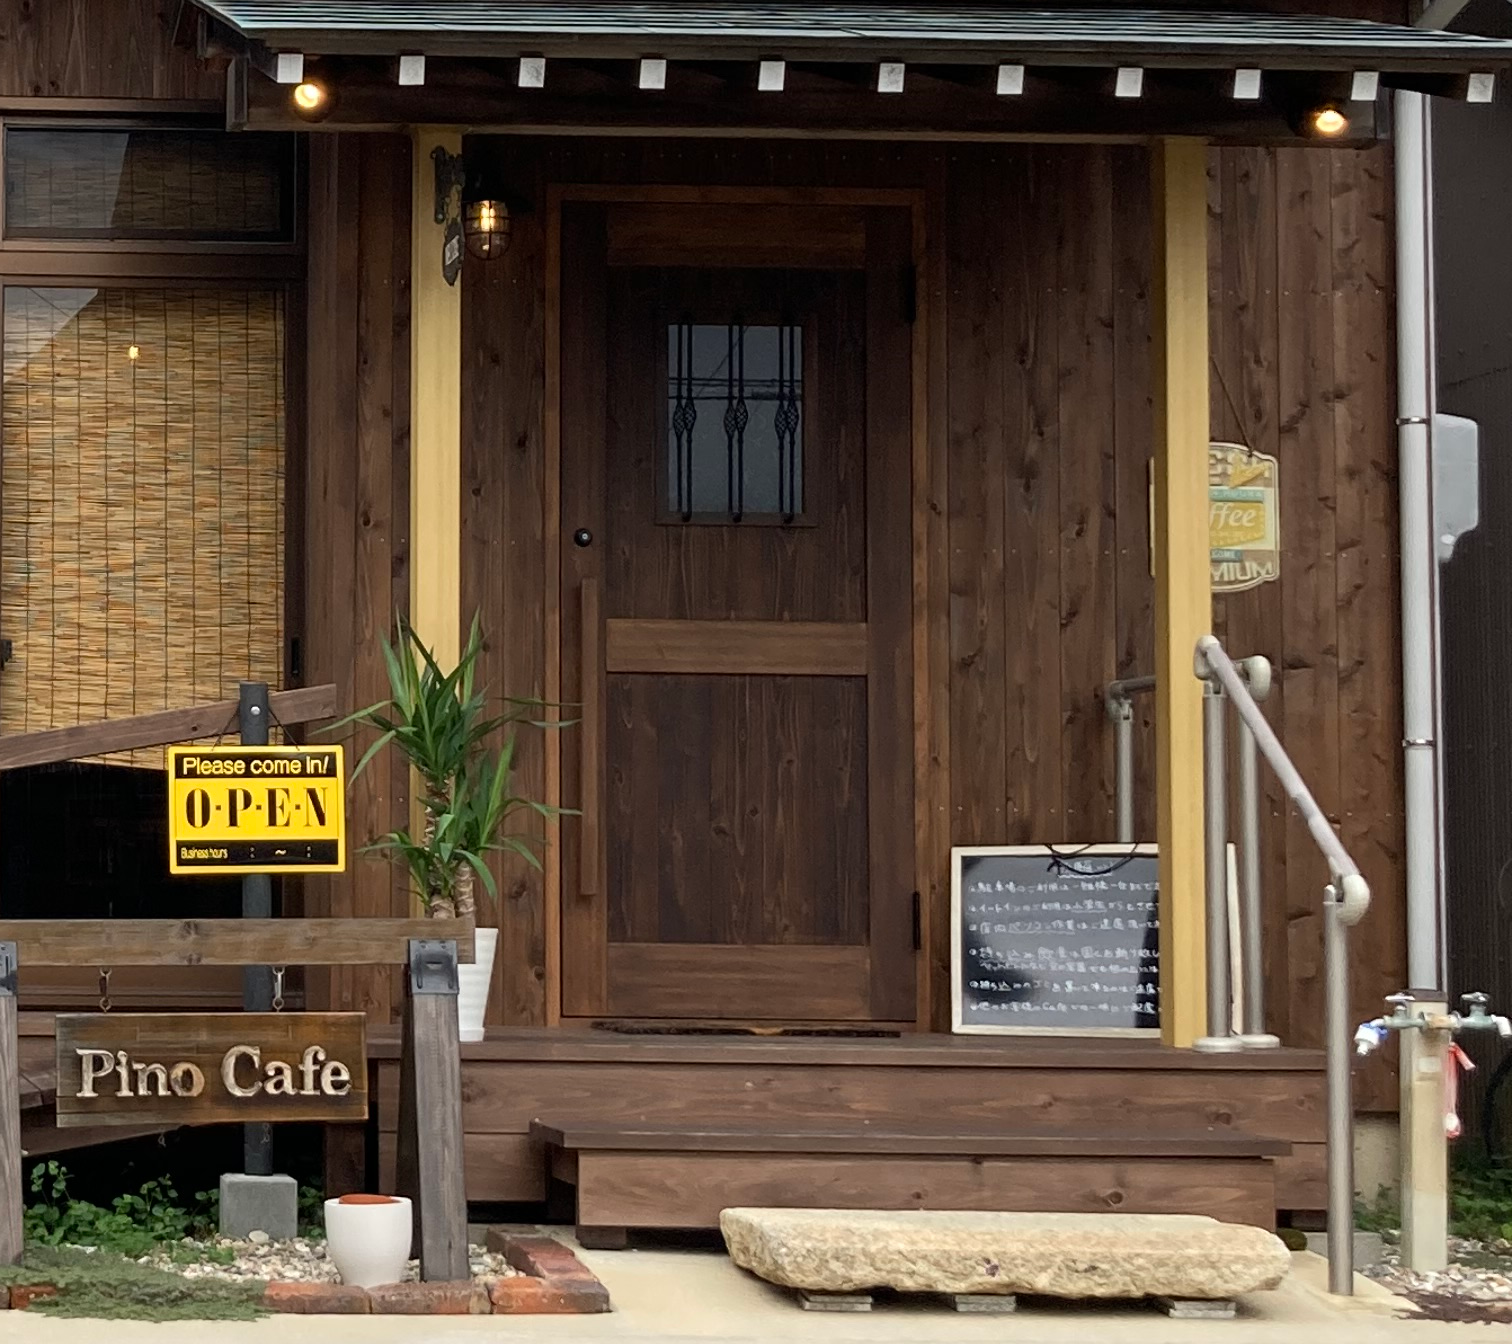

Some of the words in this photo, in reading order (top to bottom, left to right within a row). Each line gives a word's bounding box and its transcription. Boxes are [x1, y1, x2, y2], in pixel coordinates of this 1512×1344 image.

[1209, 502, 1256, 529] ffee
[1210, 560, 1273, 582] MIUM
[182, 756, 246, 775] Please
[249, 759, 302, 775] come
[75, 1048, 206, 1098] Pino
[219, 1045, 352, 1098] Cafe
